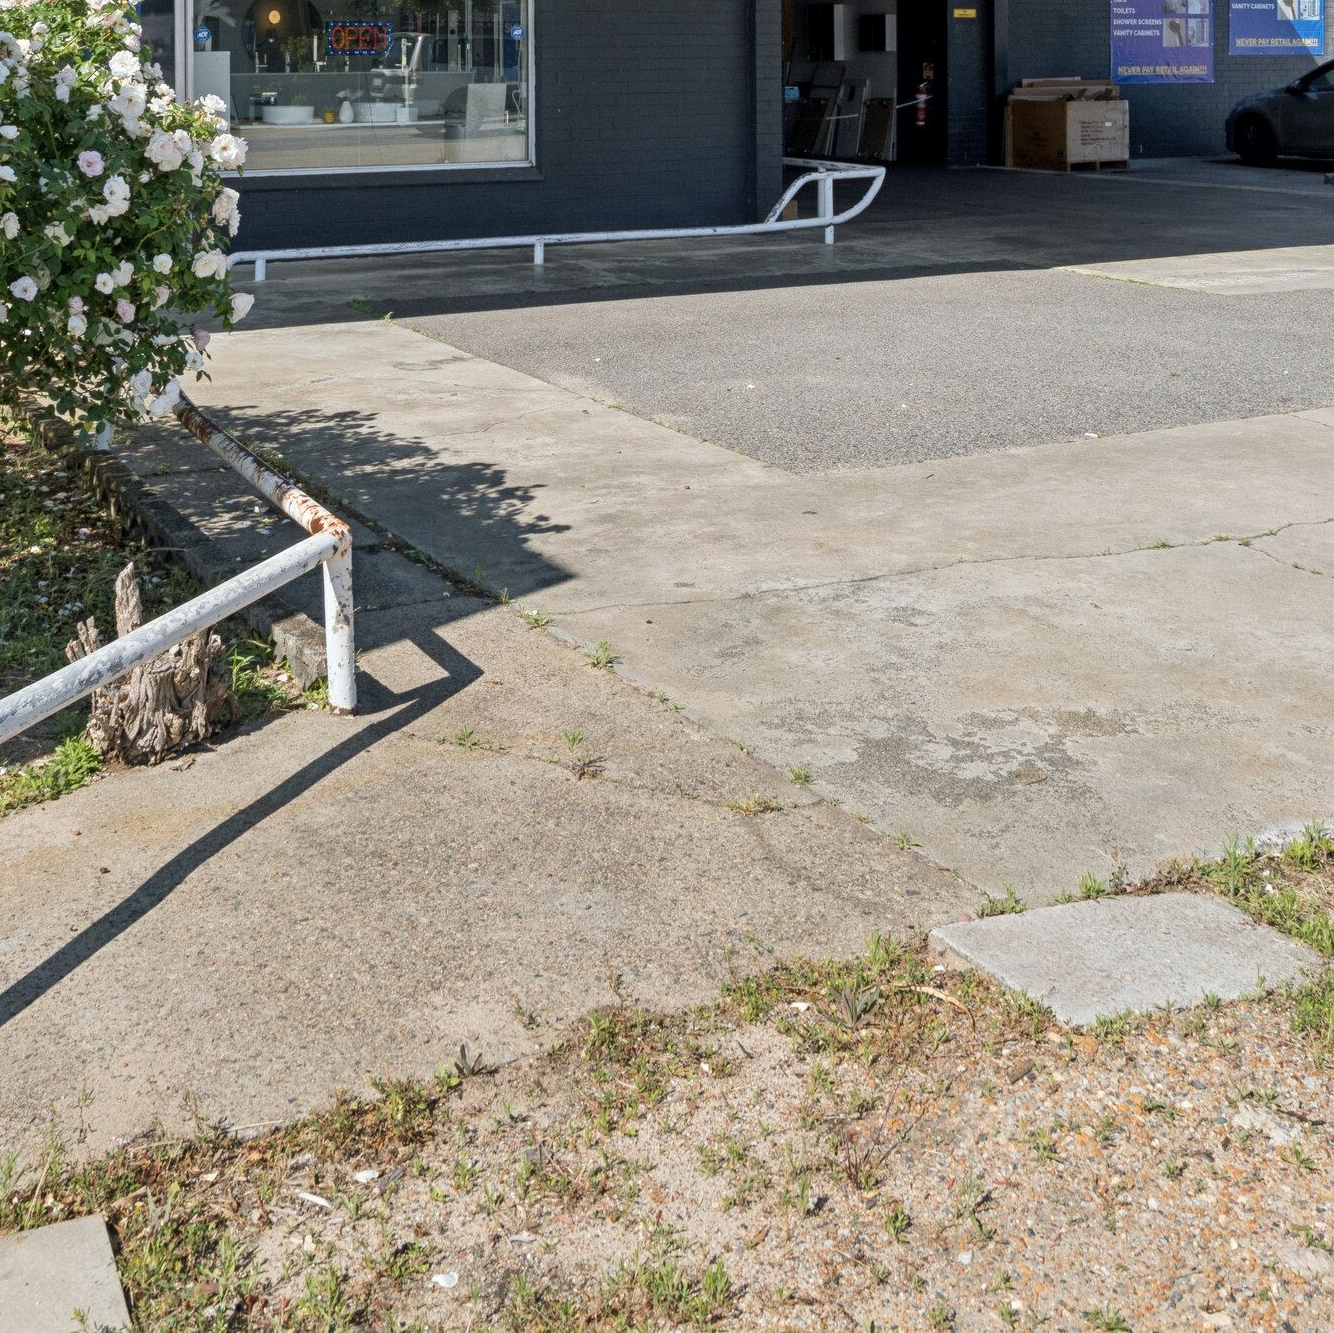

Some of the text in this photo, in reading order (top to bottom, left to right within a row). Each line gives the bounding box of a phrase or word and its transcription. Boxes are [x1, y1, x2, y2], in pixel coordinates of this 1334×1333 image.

[1113, 18, 1138, 26] SHOWER
[1113, 29, 1160, 37] VANITY CABINETS
[331, 26, 388, 50] OPEN
[1236, 38, 1258, 46] NEVER
[1259, 38, 1271, 46] PAY
[1271, 38, 1292, 46] RETAIL
[1118, 66, 1140, 75] NEVER
[1141, 66, 1155, 75] PAY
[1155, 66, 1178, 75] RETAIL
